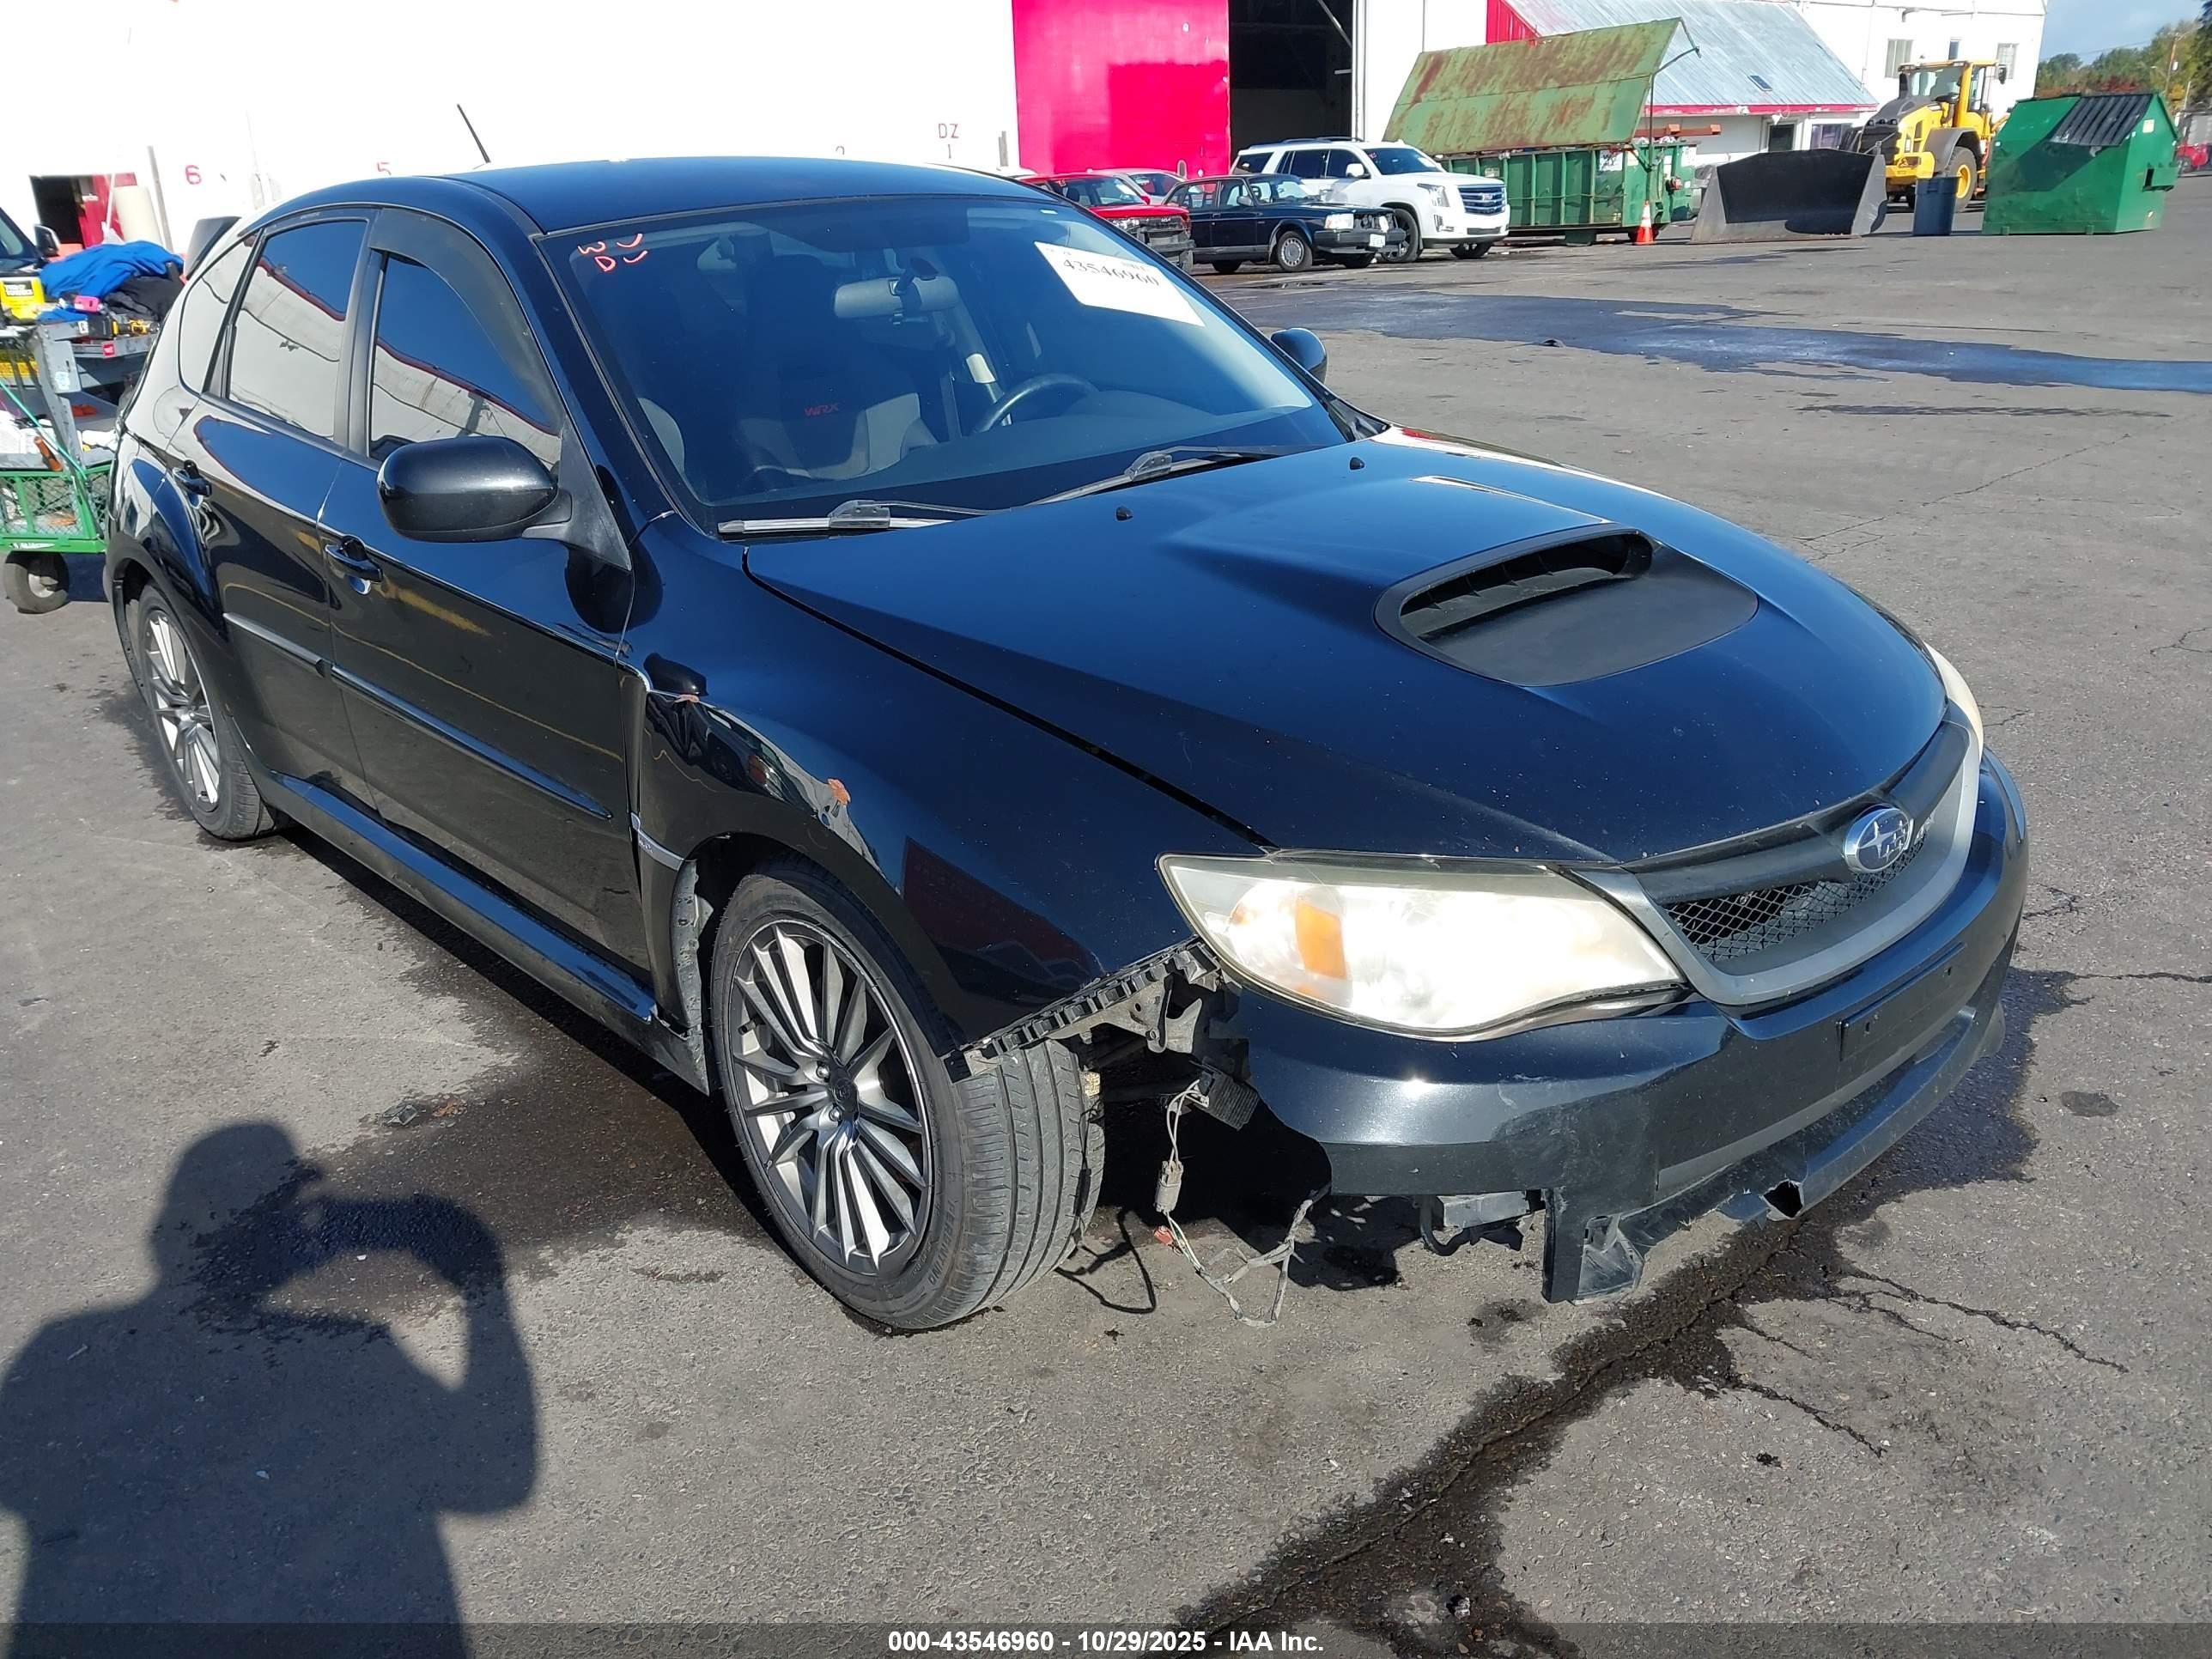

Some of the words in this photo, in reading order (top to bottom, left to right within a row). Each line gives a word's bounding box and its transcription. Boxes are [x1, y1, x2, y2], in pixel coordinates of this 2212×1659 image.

[185, 164, 203, 185] 6
[1062, 258, 1160, 286] 43546960
[804, 402, 840, 417] WRX
